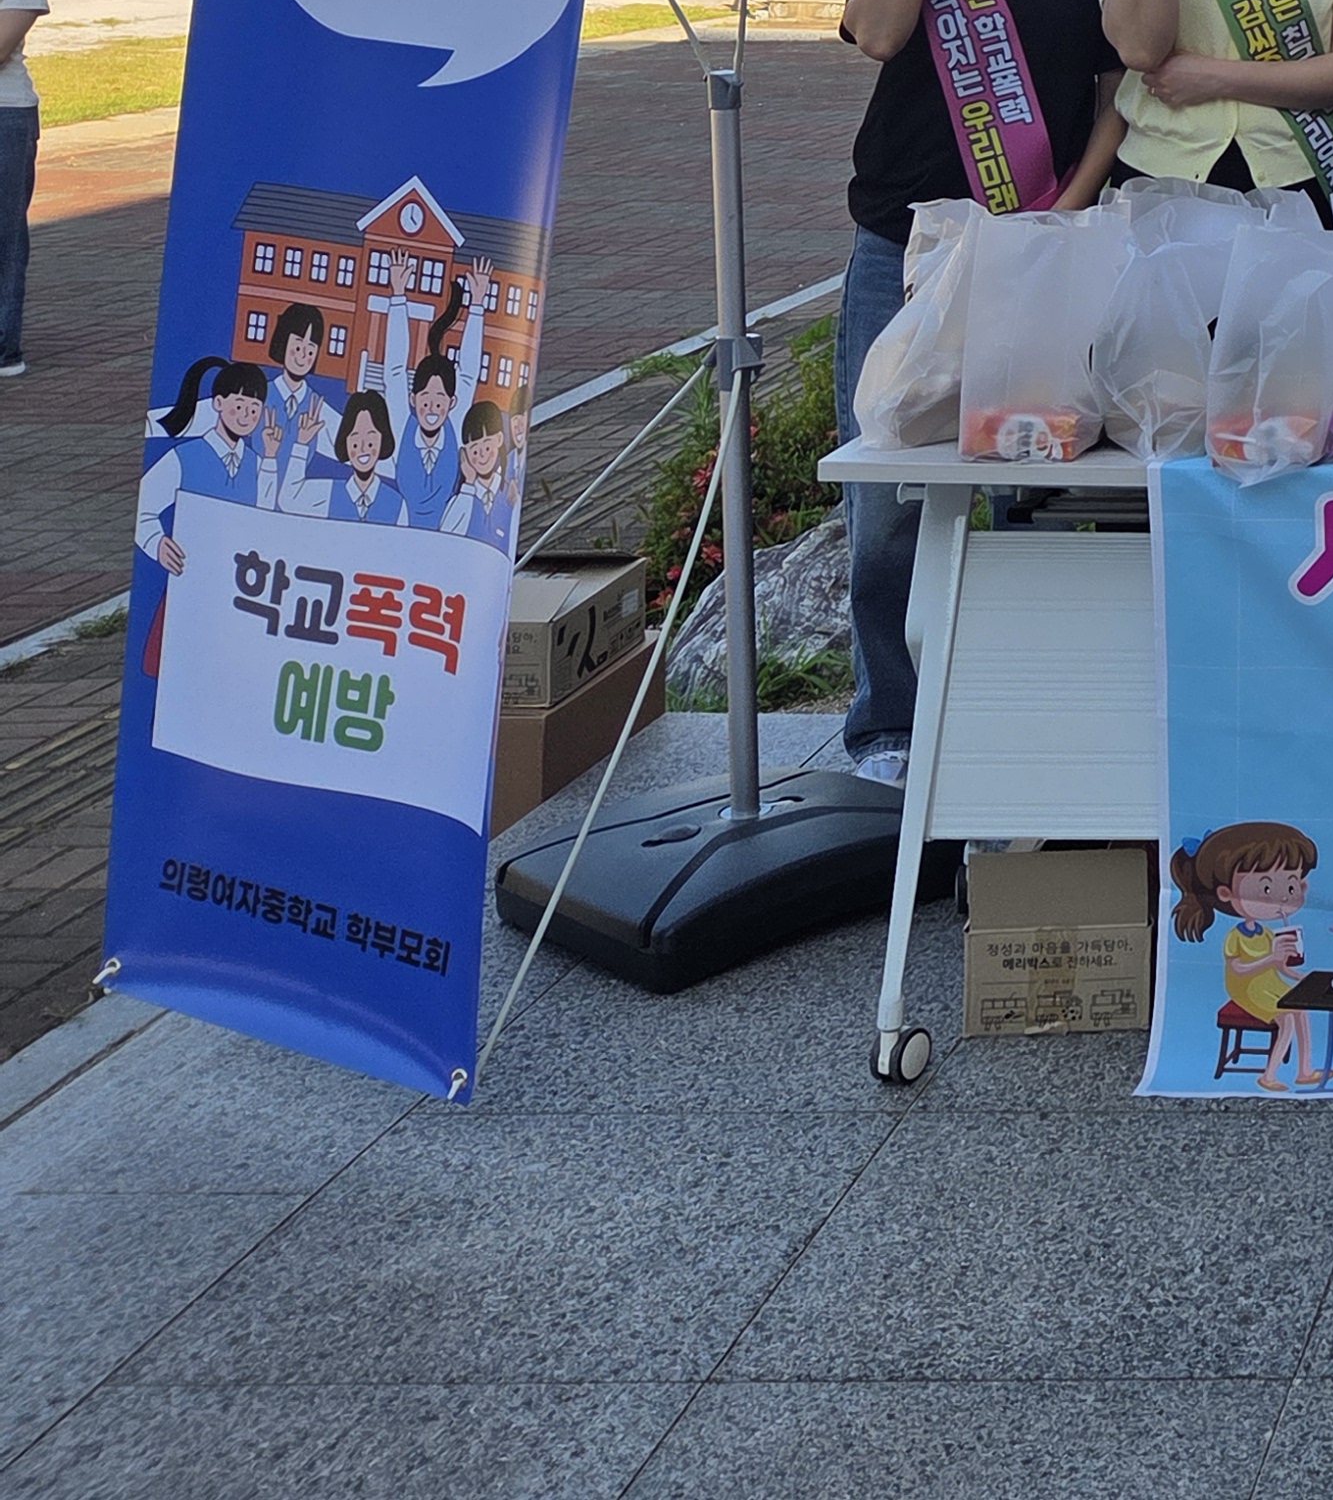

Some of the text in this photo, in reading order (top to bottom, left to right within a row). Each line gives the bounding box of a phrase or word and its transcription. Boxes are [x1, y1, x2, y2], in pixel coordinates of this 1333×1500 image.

[973, 12, 1034, 125] 학교폭력
[960, 100, 1020, 215] 우리미래
[233, 550, 466, 675] 학교폭력
[274, 660, 395, 753] 예방
[158, 857, 452, 978] 의령여자중학교 학부모회
